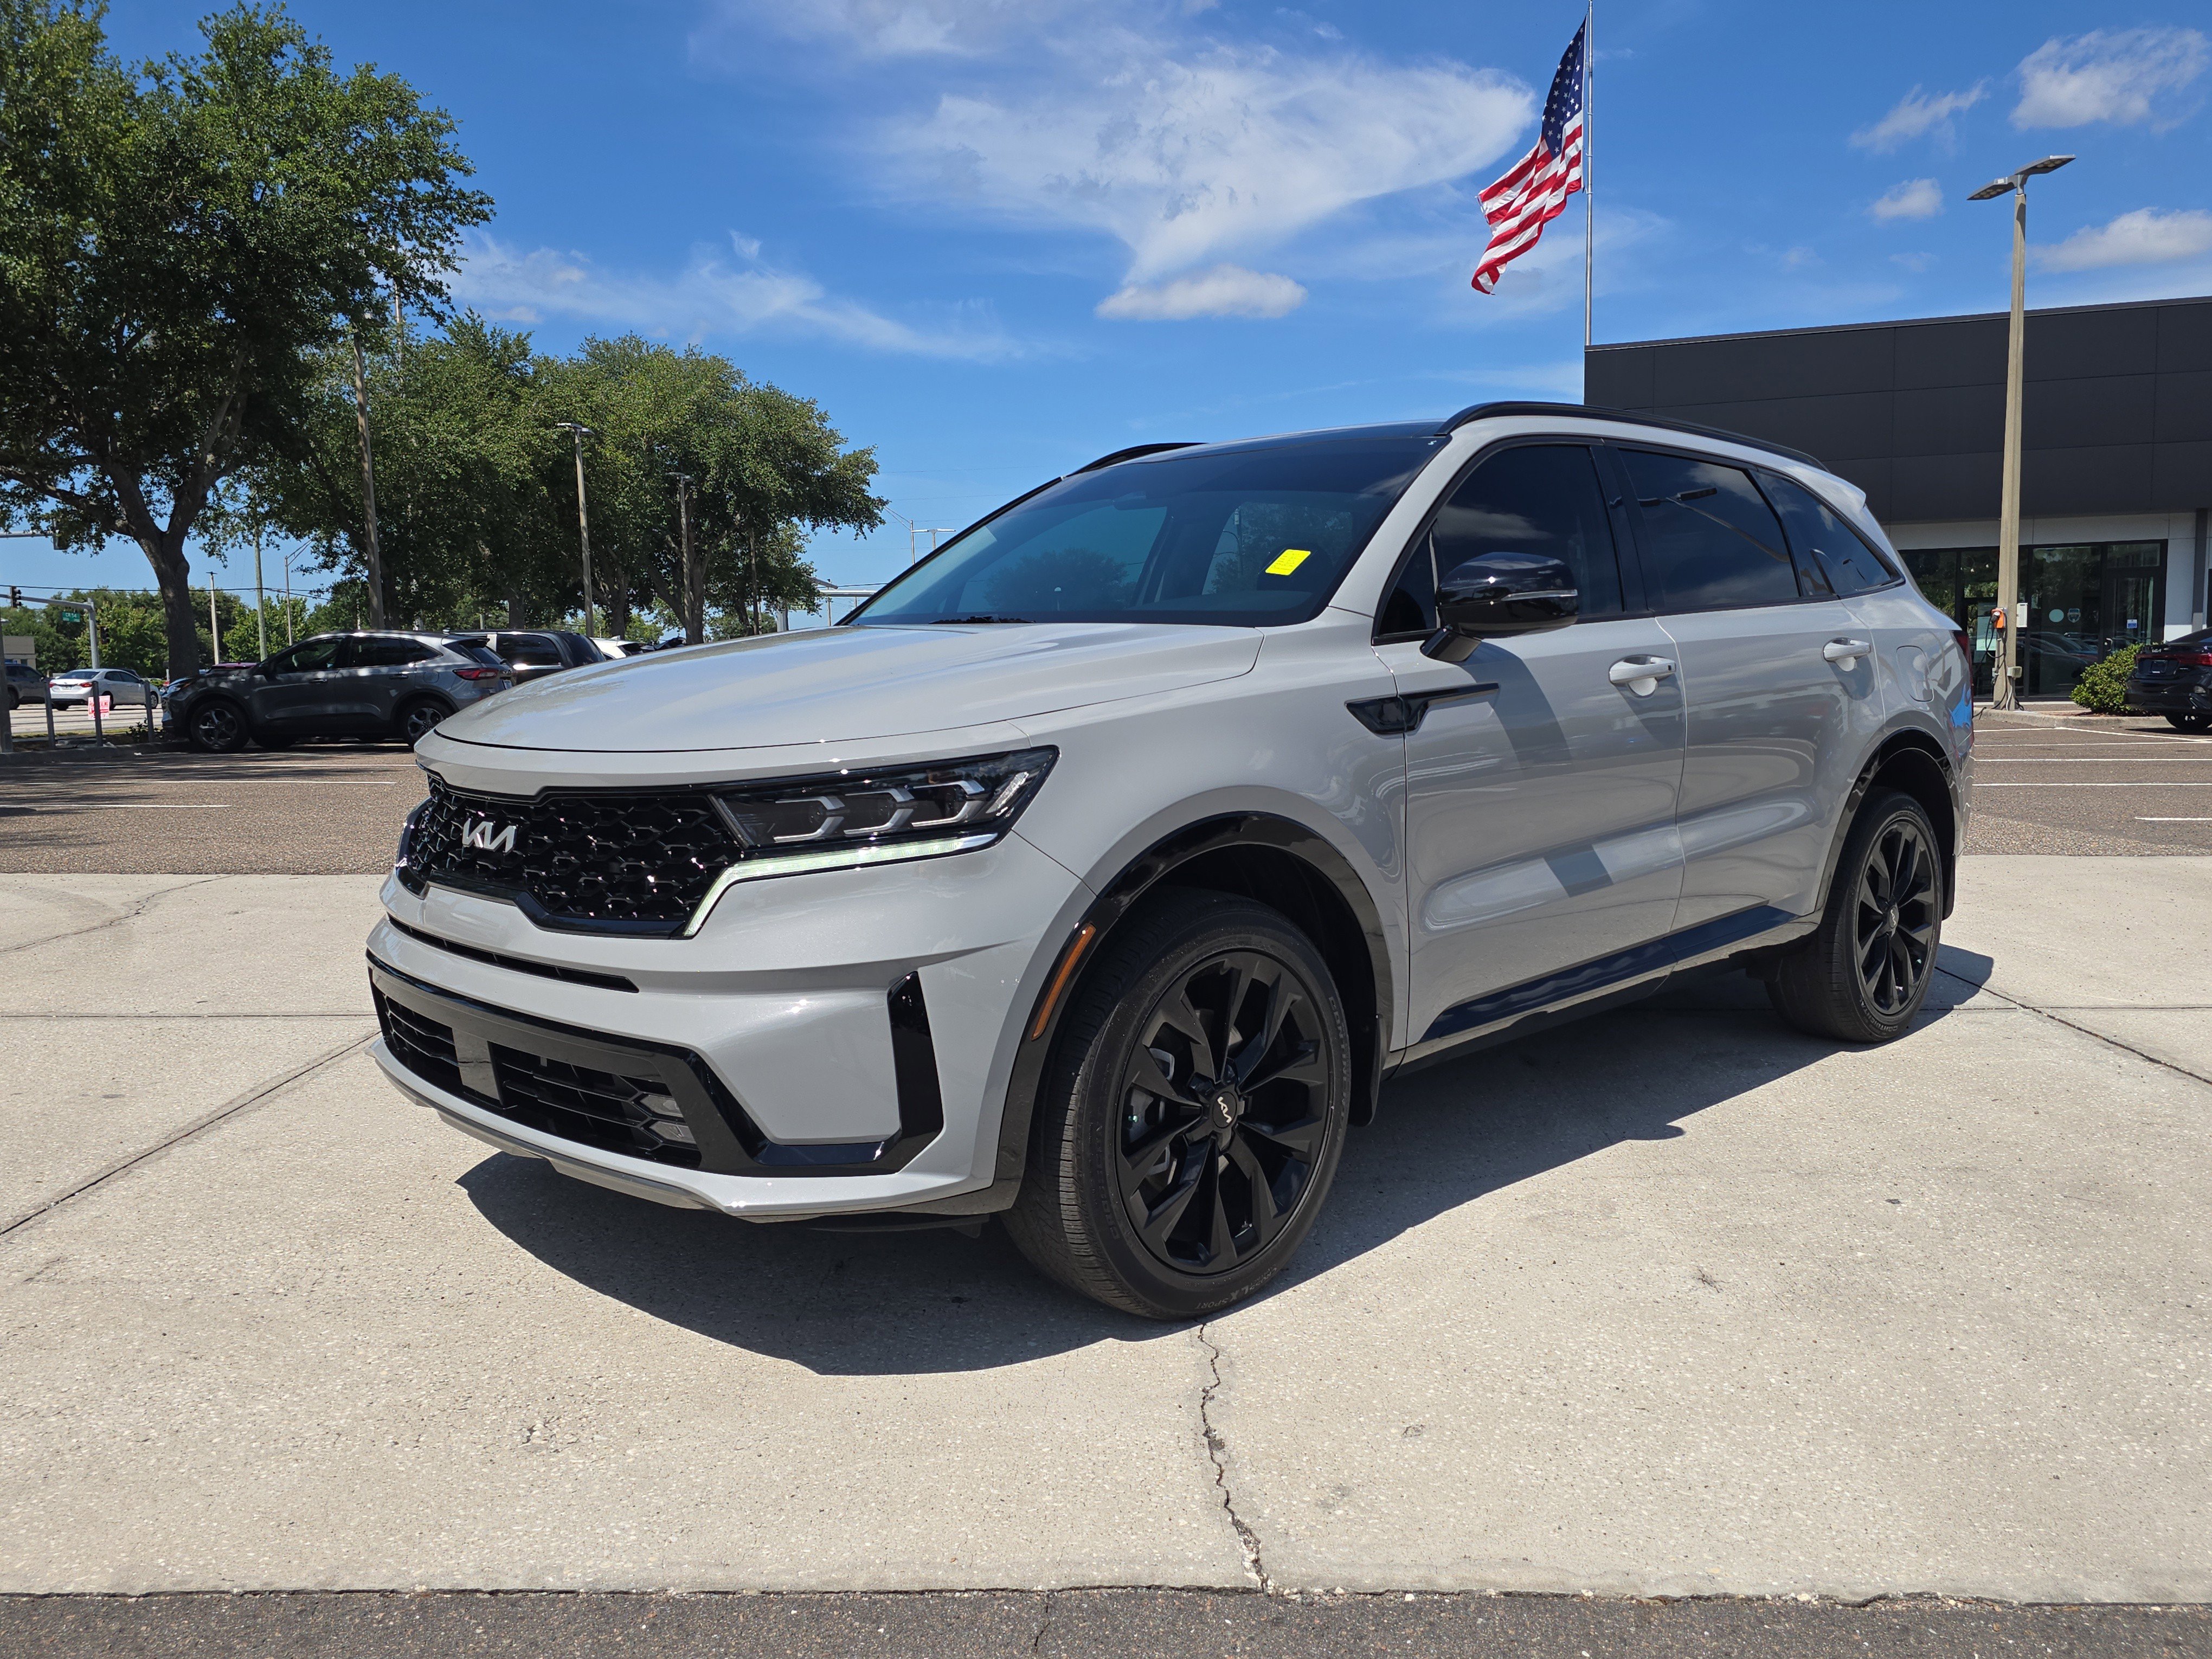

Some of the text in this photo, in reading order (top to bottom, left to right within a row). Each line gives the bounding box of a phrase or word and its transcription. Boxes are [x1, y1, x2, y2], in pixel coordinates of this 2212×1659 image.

[462, 818, 517, 854] KIA
[1217, 1096, 1232, 1123] KIA
[1194, 1297, 1229, 1310] SPORT
